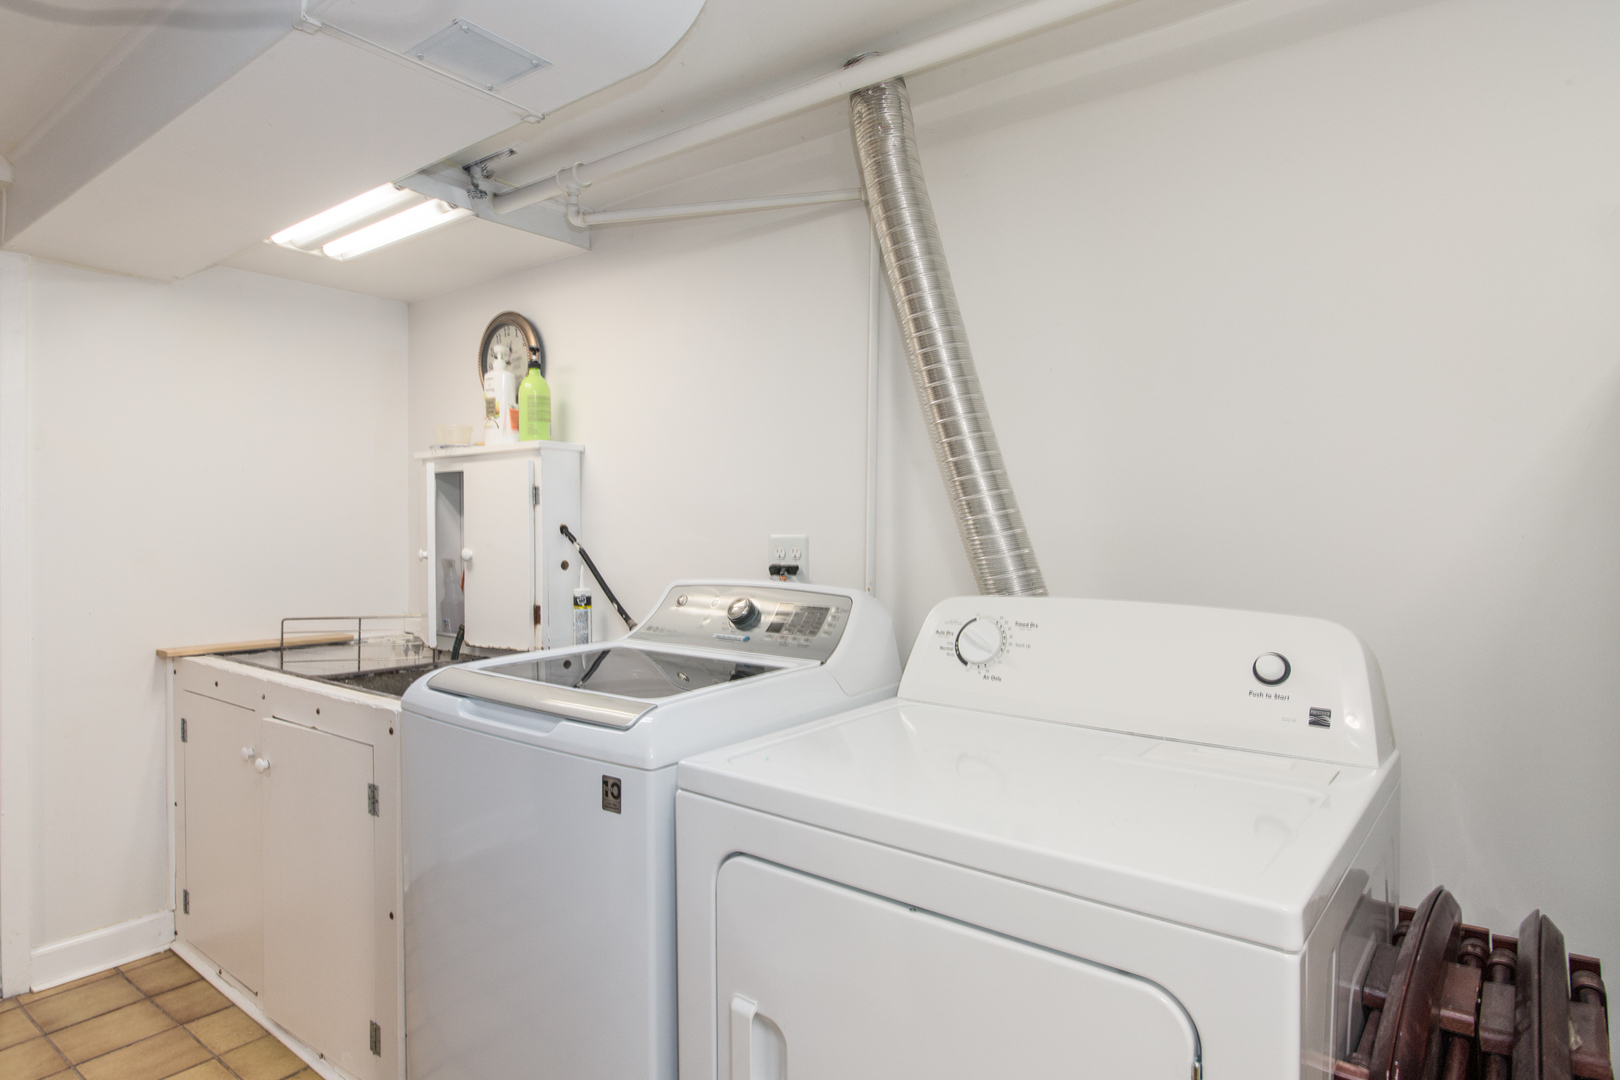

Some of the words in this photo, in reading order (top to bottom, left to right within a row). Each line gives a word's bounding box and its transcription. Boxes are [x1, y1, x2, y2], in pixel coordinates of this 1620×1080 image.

[504, 326, 510, 337] 12
[1248, 690, 1264, 698] Push
[1274, 693, 1290, 701] Start
